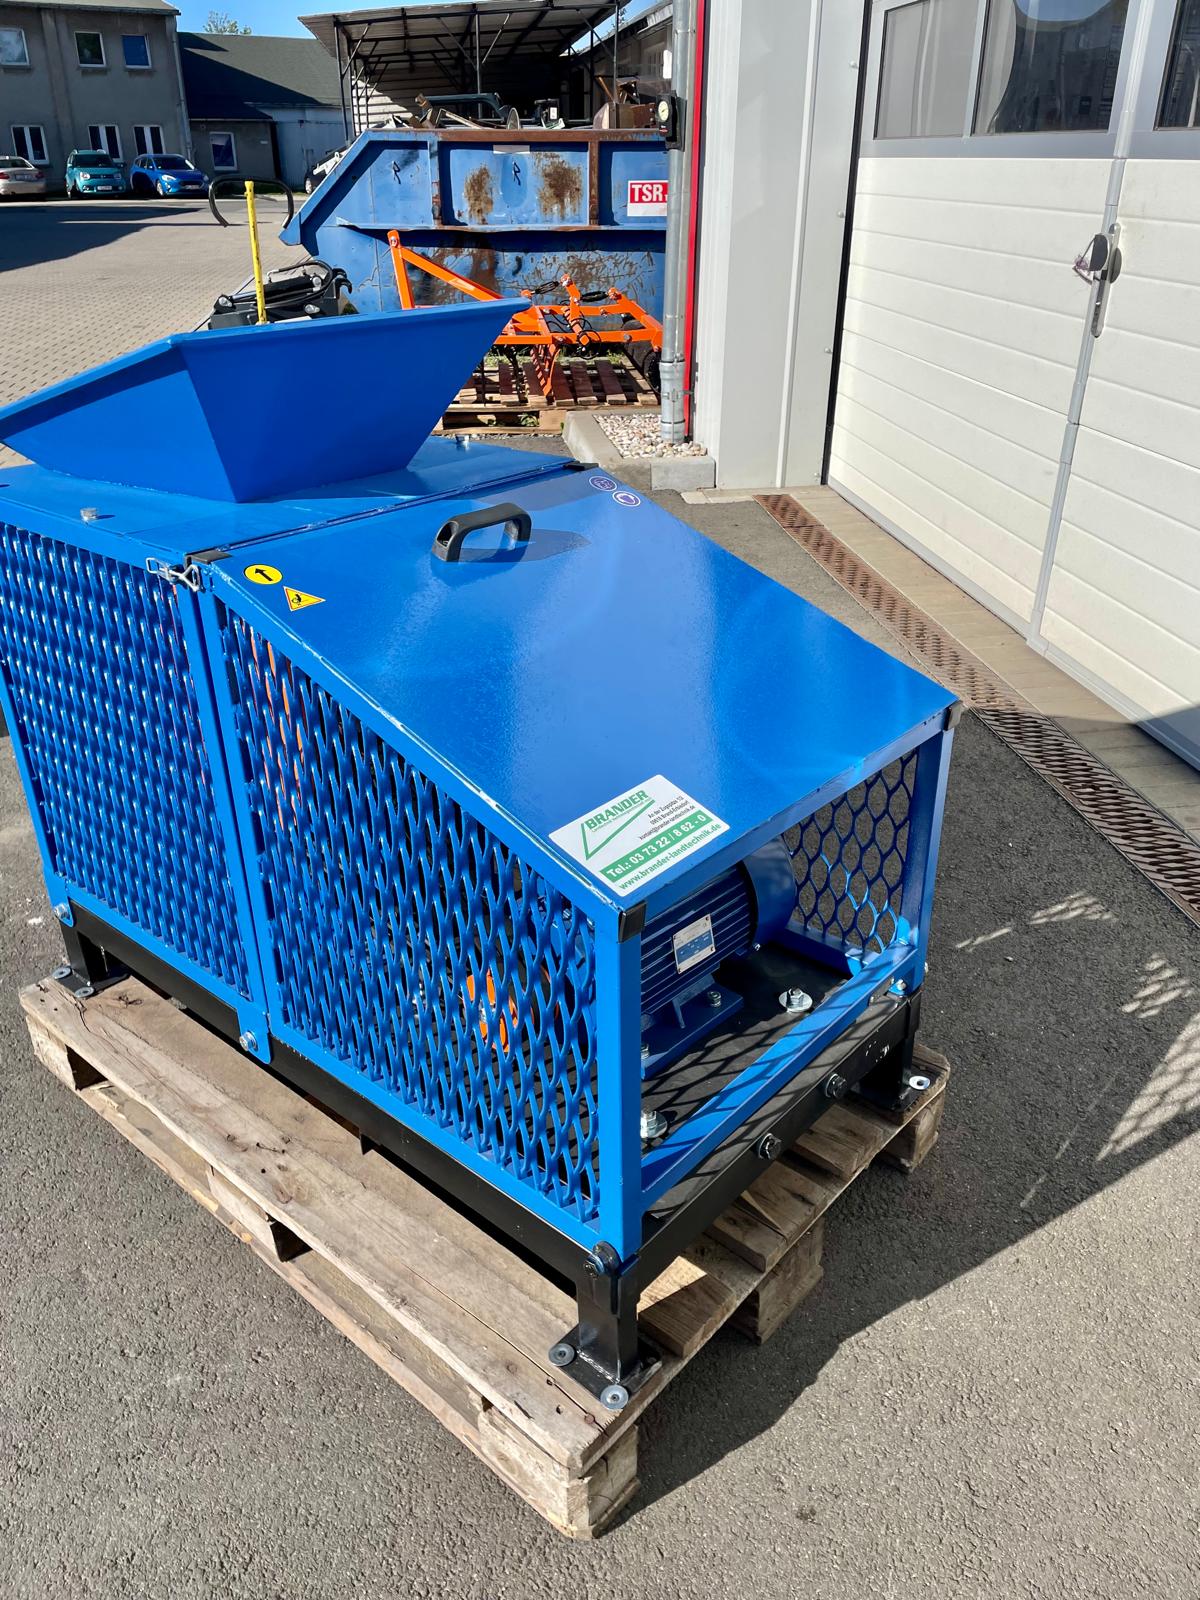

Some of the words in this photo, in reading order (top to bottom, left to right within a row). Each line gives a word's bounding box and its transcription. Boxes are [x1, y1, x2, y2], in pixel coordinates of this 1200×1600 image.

[631, 184, 664, 202] TSR
[585, 790, 648, 829] BRANDER
[606, 860, 632, 878] Tel.:
[628, 852, 645, 864] 03
[641, 844, 658, 856] 73
[654, 836, 671, 848] 22
[671, 828, 683, 837] 8
[678, 820, 695, 832] 62
[696, 813, 707, 822] 0
[619, 822, 722, 890] www.brander-landtechnik.de
